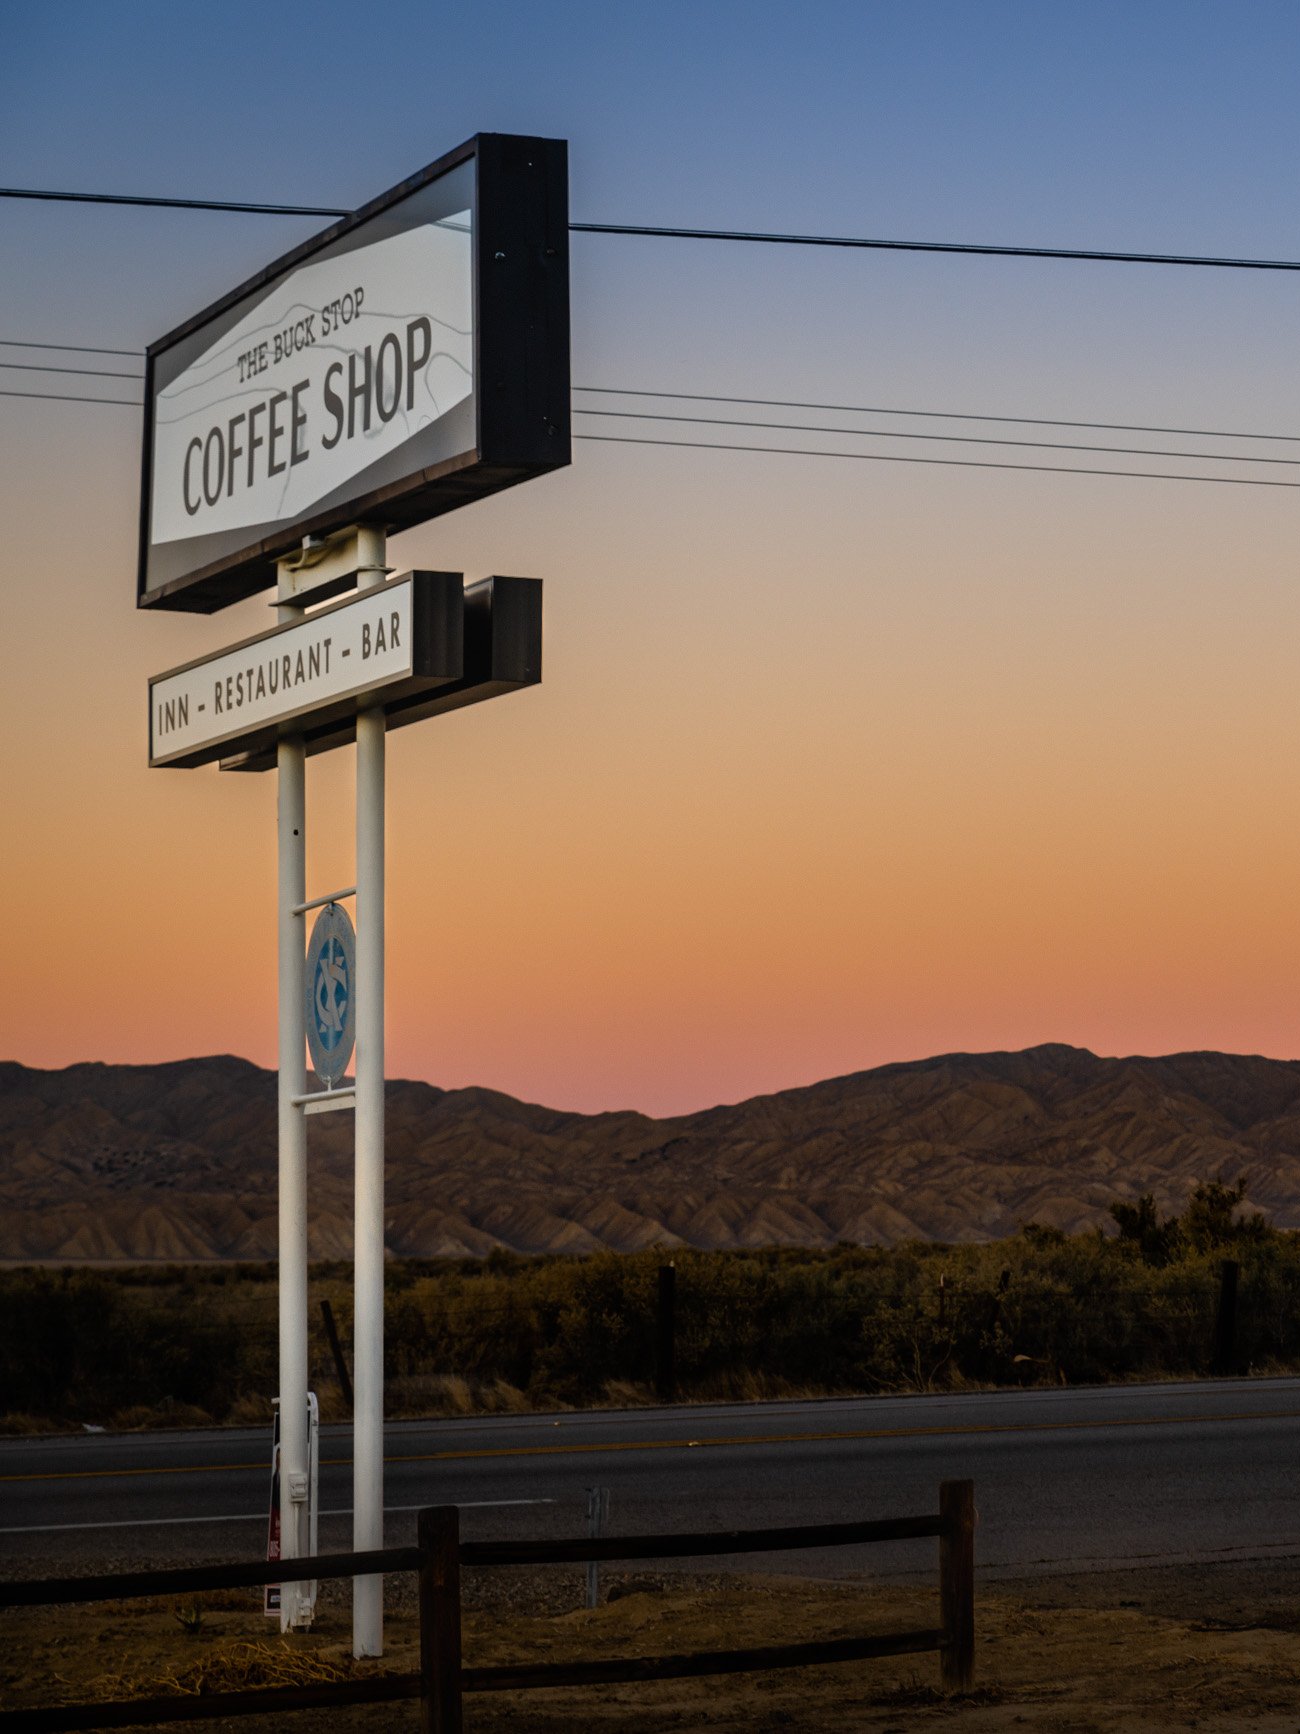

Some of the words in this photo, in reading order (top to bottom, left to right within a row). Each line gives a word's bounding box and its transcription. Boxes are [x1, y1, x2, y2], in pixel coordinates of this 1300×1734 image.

[237, 342, 268, 383] THE
[274, 314, 316, 366] BUCK
[321, 286, 365, 337] STOP
[183, 378, 311, 516] COFFEE
[321, 315, 432, 450] SHOP
[159, 694, 189, 736] INN
[214, 638, 332, 716] RESTAURANT
[362, 611, 401, 660] BAR
